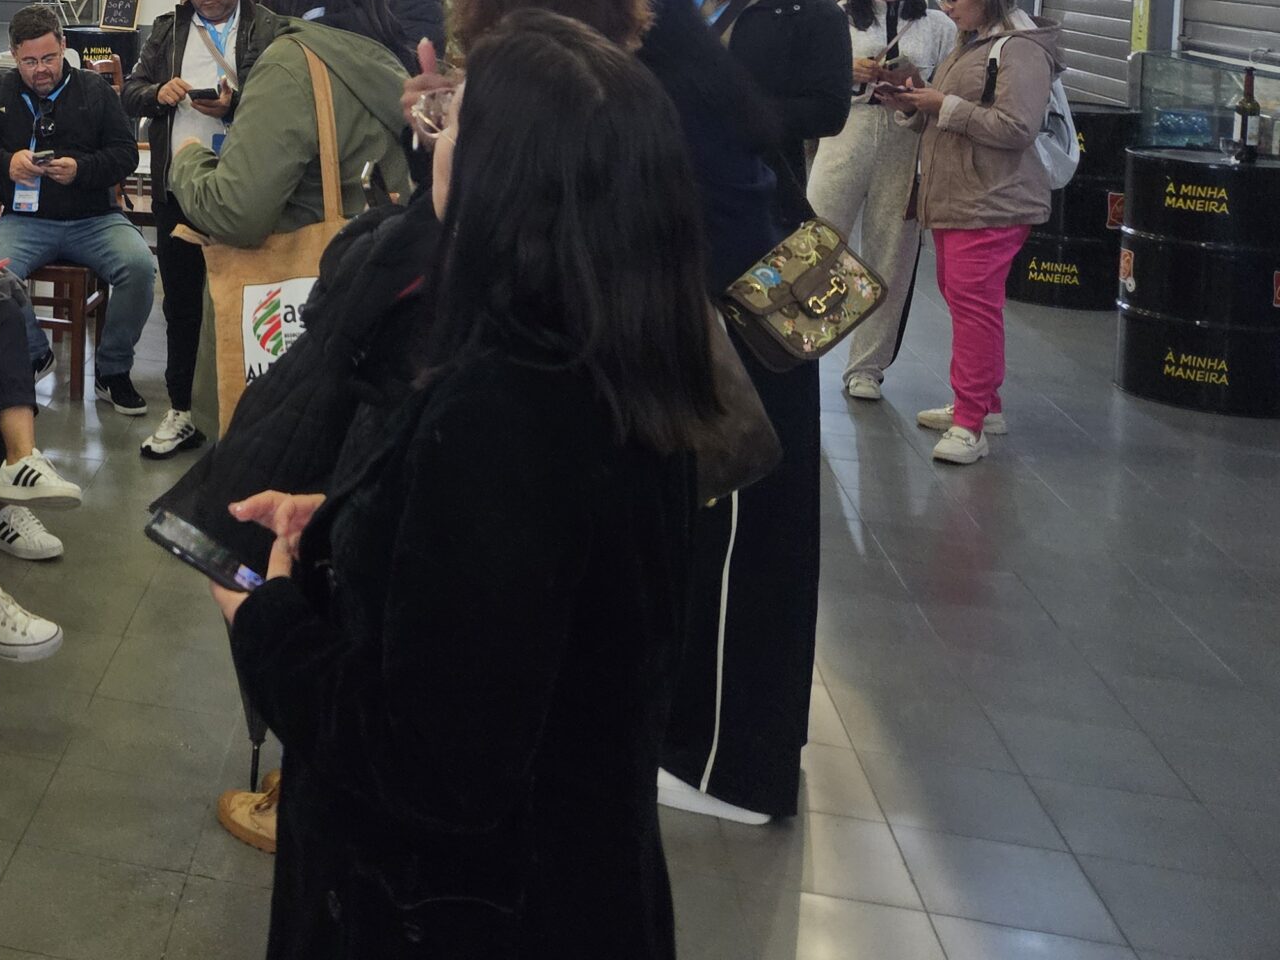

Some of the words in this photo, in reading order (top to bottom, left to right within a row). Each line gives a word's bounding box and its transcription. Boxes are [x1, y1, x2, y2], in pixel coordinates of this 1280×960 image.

[1180, 184, 1229, 200] MINHA
[1164, 195, 1230, 215] MANEIRA
[1040, 261, 1079, 274] MINHA
[1028, 271, 1080, 286] MANEIRA
[1180, 353, 1229, 372] MINHA
[1163, 364, 1229, 386] MANEIRA
